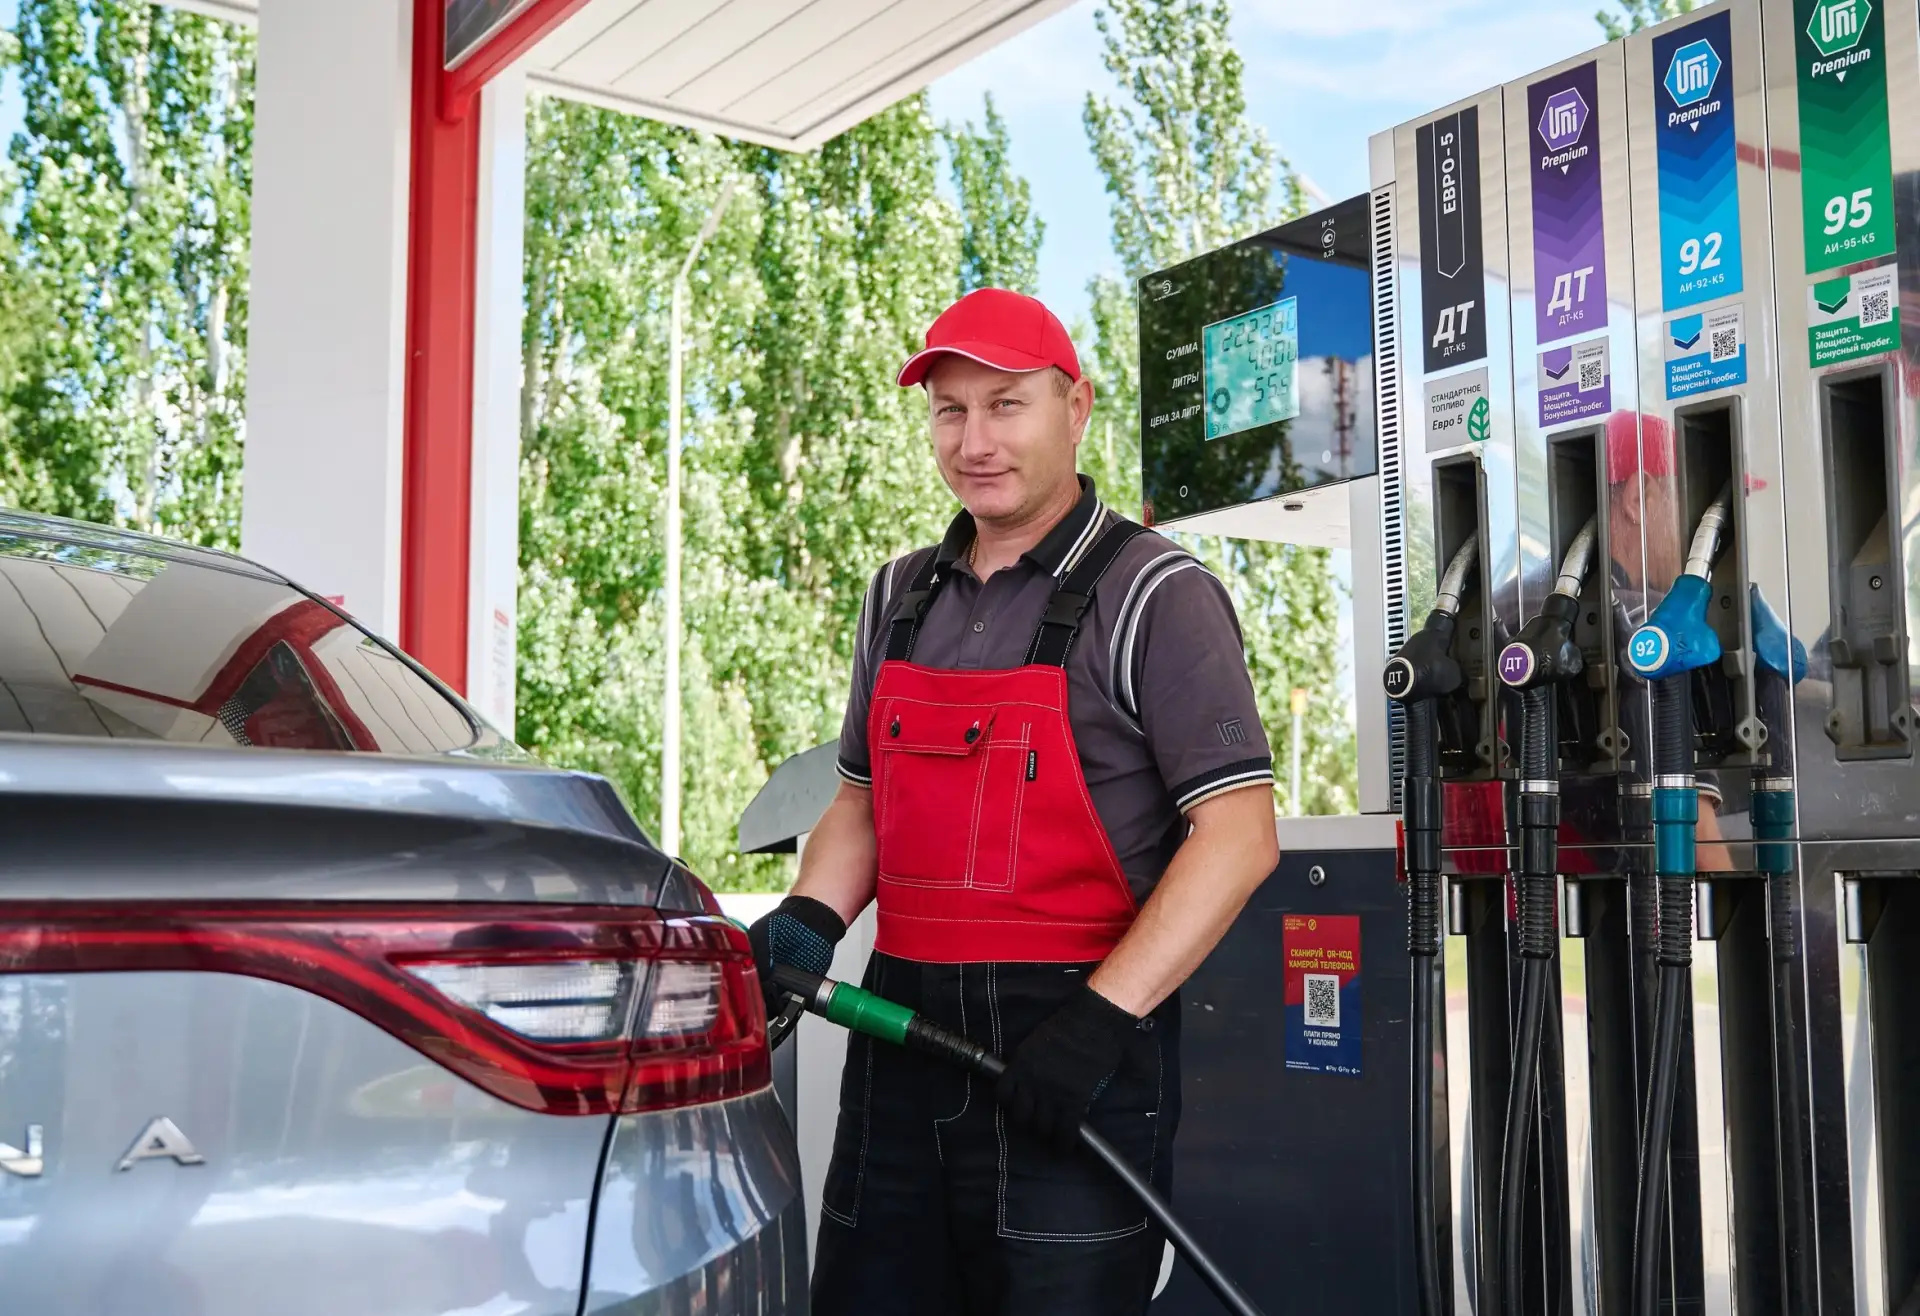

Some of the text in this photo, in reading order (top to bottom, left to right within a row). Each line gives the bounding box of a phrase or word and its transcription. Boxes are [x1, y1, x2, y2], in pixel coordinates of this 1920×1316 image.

[1812, 48, 1871, 78] Premium
[1676, 53, 1709, 95] Uni
[1548, 101, 1578, 140] Uni
[1668, 100, 1720, 128] Premium
[1541, 145, 1588, 170] Premium
[1440, 132, 1457, 214] ЕВРО-5
[1823, 187, 1873, 236] 95
[1824, 232, 1876, 255] АИ-95-К5
[1678, 231, 1723, 276] 92
[1546, 266, 1594, 317] ДТ
[1679, 273, 1725, 294] АИ-92-К5
[1432, 300, 1475, 348] ДТ
[1558, 309, 1584, 326] ДТ-К5
[1815, 326, 1851, 340] Защита.
[1815, 335, 1864, 350] Мощность.
[1166, 341, 1198, 361] СУММА
[1443, 341, 1466, 357] ДТ-К5
[1816, 337, 1893, 360] Бонусный пробег.
[1671, 361, 1703, 374] Защита.
[1671, 369, 1715, 383] Мощность.
[1172, 371, 1200, 390] ЛИТРЫ
[1672, 372, 1740, 393] Бонусный пробег.
[1431, 384, 1481, 403] СТАНДАРТНОЕ
[1544, 391, 1573, 403] Защита.
[1150, 404, 1201, 428] ЦЕНА ЗА ЛИТР
[1431, 399, 1465, 414] ТОПЛИВО
[1544, 401, 1605, 421] Бонусный пробег.
[1432, 414, 1463, 431] Евро 5
[1635, 639, 1656, 657] 92
[1504, 656, 1523, 673] ДТ
[1387, 670, 1403, 687] ДТ
[1290, 947, 1353, 960] СКАНИРУЙ QR-КОД
[1288, 958, 1355, 971] КАМЕРОЙ ТЕЛЕФОНА
[1303, 1030, 1341, 1040] ПЛАТИ ПРЯМО
[1313, 1039, 1338, 1047] КОЛОНКИ
